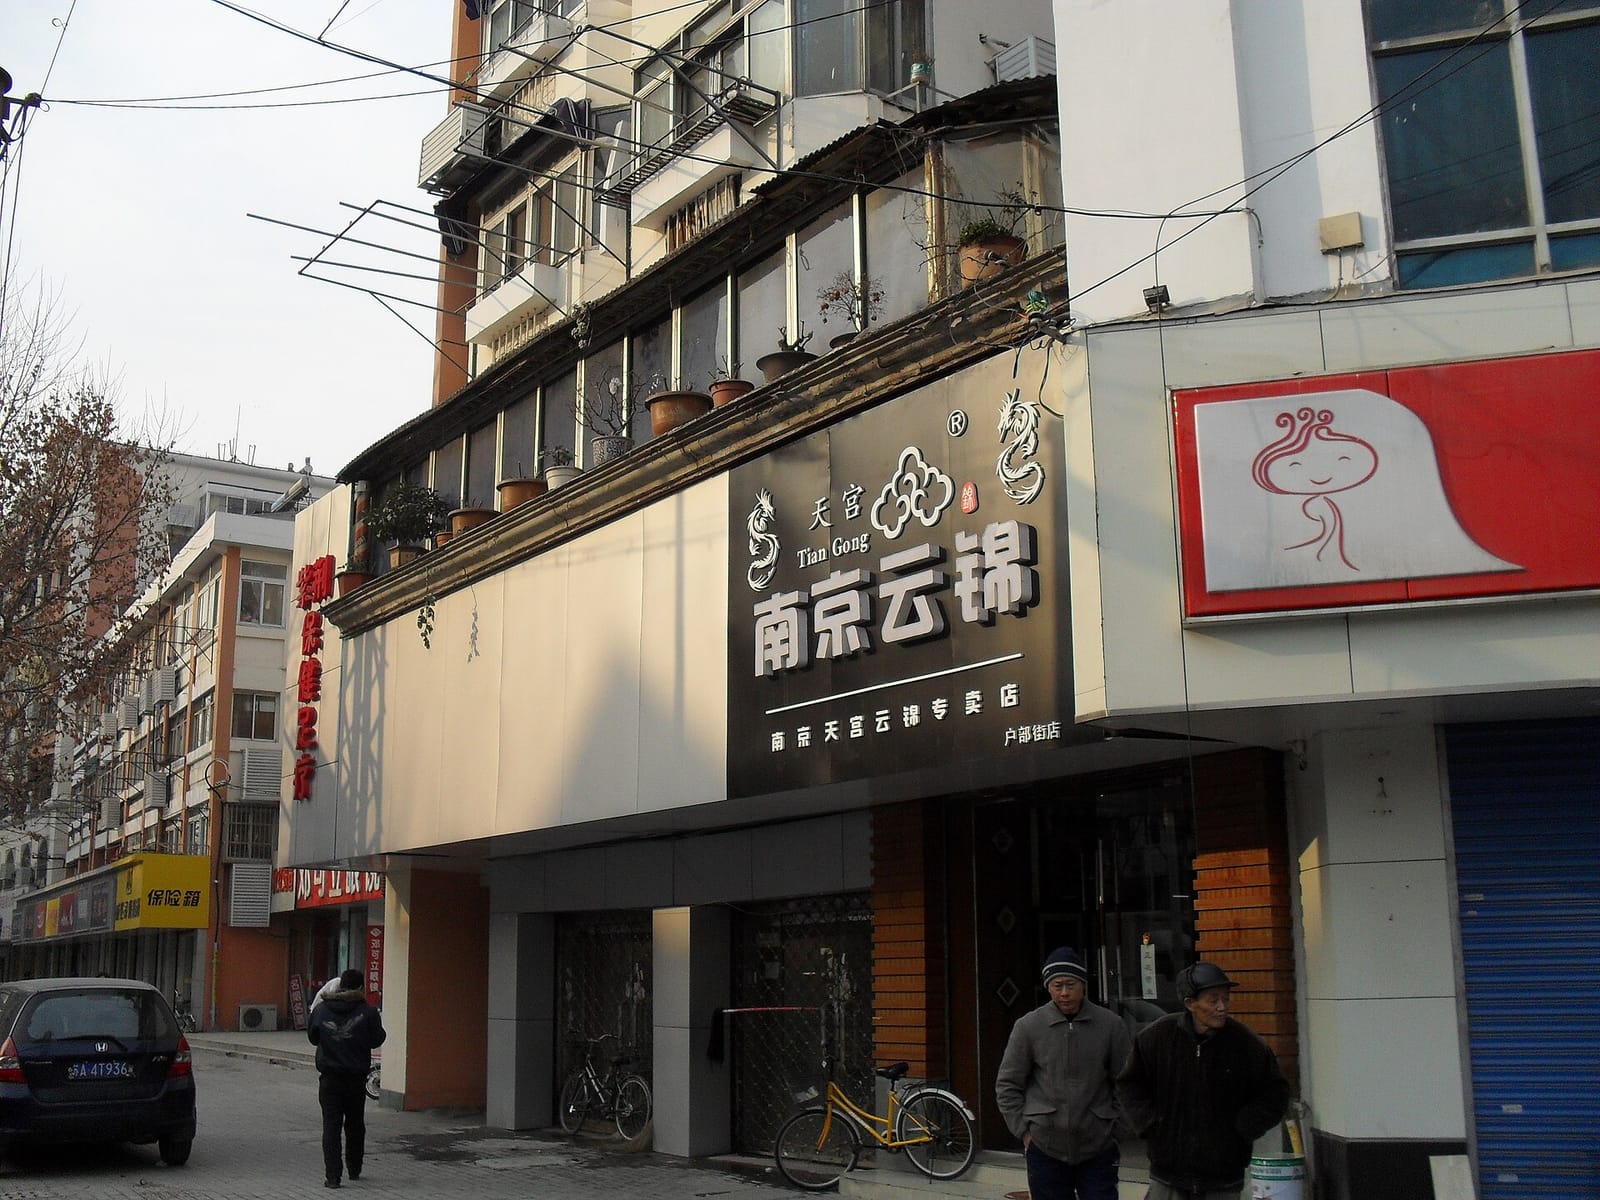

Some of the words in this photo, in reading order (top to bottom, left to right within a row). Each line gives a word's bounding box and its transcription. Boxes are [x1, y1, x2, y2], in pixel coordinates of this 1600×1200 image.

[809, 483, 865, 531] 天宫
[797, 546, 829, 569] Tian
[832, 533, 871, 554] Gong
[752, 520, 1036, 677] 南京云锦
[771, 683, 1020, 752] 南京天宫云锦专卖店
[1004, 721, 1061, 747] 户部街店
[147, 888, 201, 907] 保险箱
